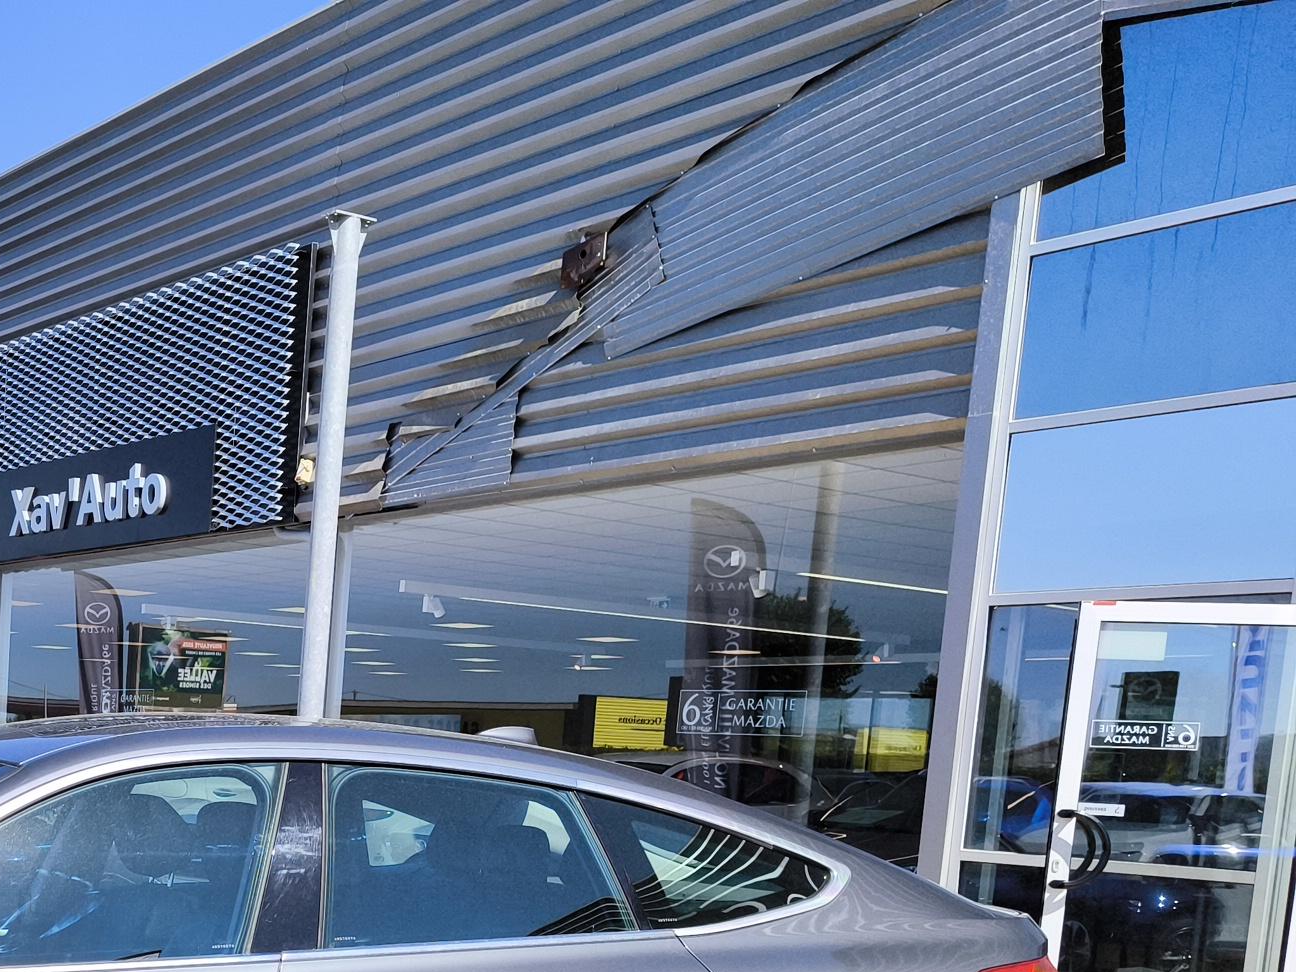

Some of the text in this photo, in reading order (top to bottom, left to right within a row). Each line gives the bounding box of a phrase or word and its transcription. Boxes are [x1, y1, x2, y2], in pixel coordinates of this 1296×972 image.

[9, 463, 168, 537] Xav'Auto
[682, 694, 701, 725] 6
[727, 698, 796, 711] GARANTIE
[732, 715, 786, 728] MAZDA
